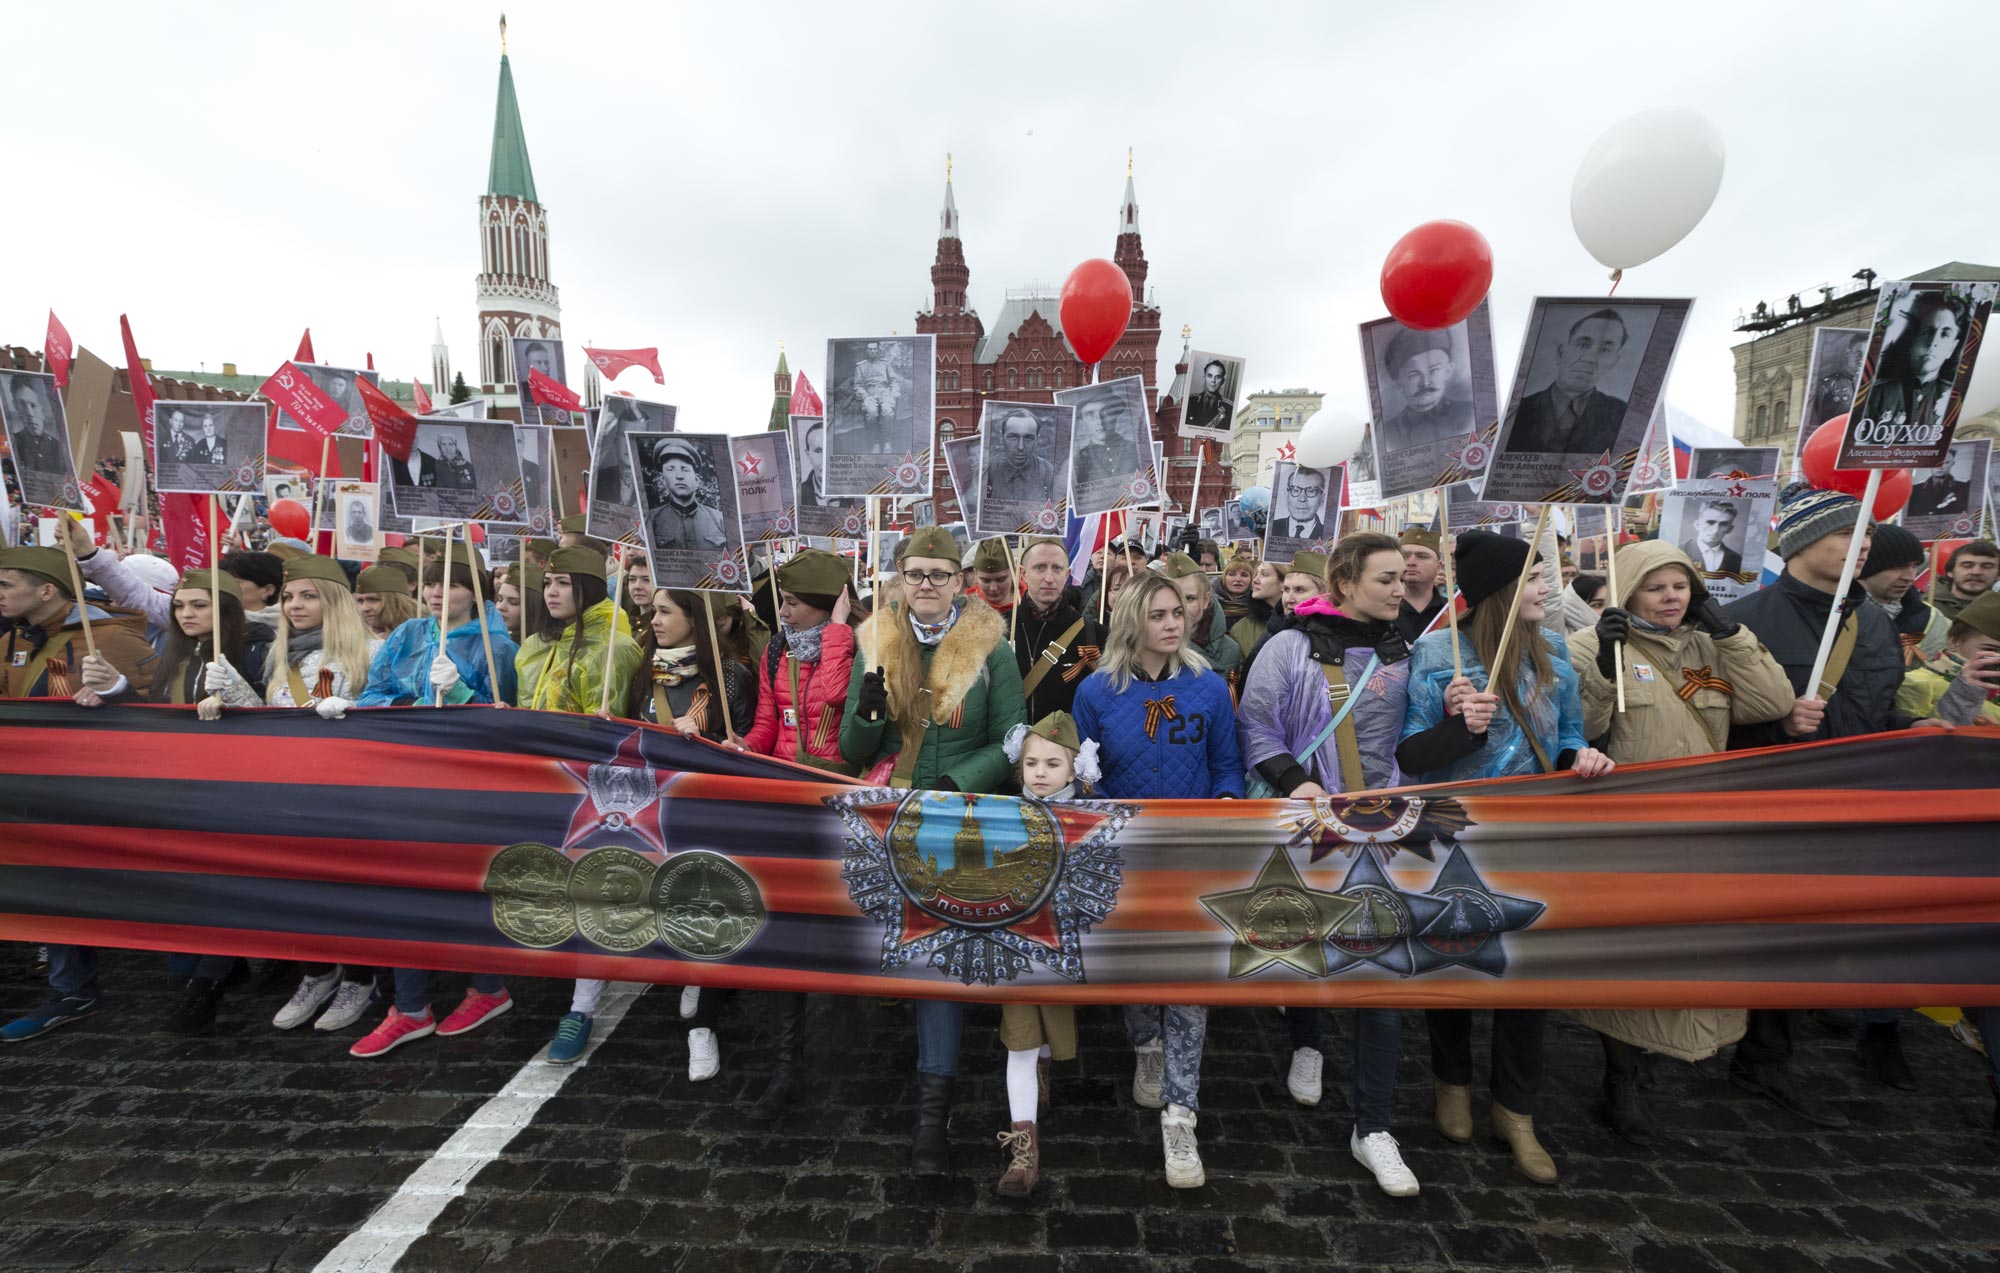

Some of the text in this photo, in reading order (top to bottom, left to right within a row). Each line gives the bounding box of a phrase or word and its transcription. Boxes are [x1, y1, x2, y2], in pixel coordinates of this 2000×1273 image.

[1854, 411, 1944, 448] Обухов
[1847, 448, 1940, 458] Александр Федорович
[1496, 462, 1563, 470] Петр Алексеевич
[1169, 714, 1204, 744] 23
[575, 850, 656, 886] НАШЕ ДЕЛО ПРА
[580, 908, 597, 933] МЫ
[937, 899, 1011, 917] ПОБЕДА
